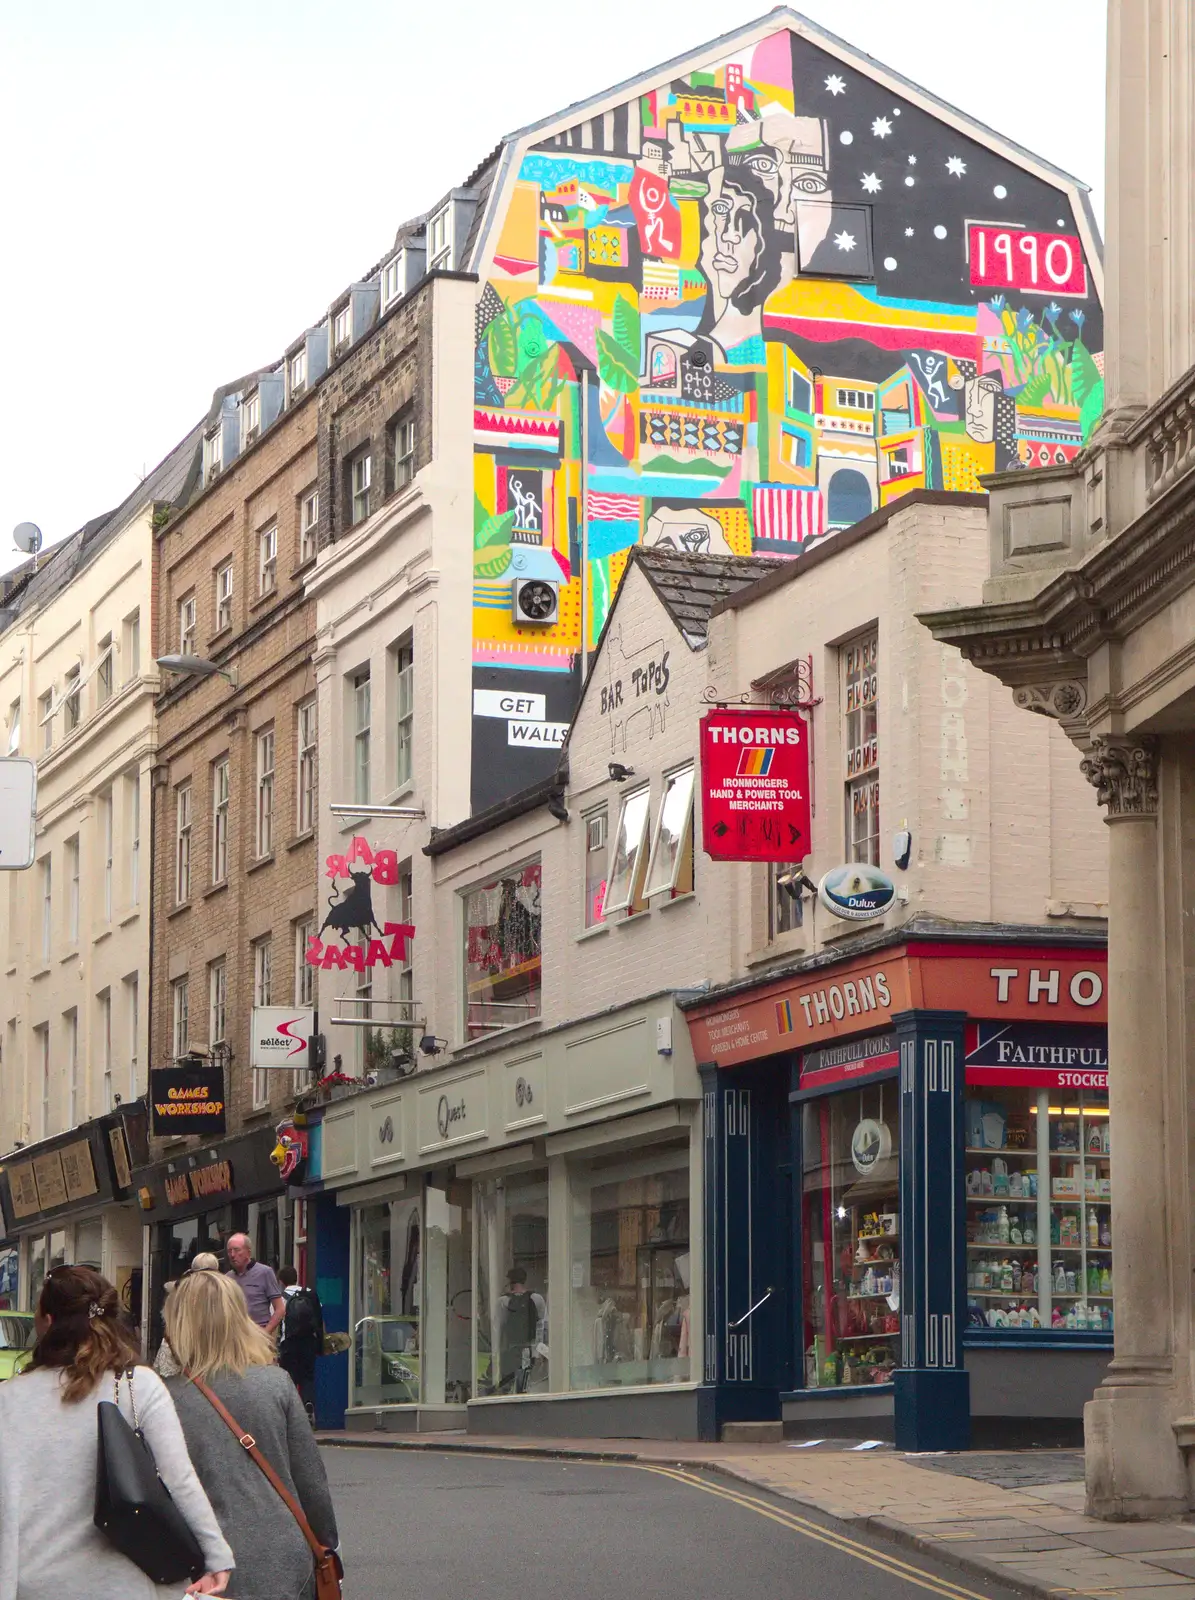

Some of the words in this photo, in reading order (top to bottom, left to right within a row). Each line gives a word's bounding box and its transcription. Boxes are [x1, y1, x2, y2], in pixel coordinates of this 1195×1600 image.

[979, 232, 1073, 285] 1990
[500, 698, 535, 714] GET
[601, 679, 624, 716] BAR
[512, 725, 569, 743] WALLS
[708, 726, 800, 745] THORNS
[848, 742, 877, 777] HOME
[723, 778, 788, 789] IRONMONGERS
[710, 789, 734, 798] HAND
[736, 789, 743, 799] &
[745, 789, 776, 800] POWER
[778, 789, 802, 800] TOOL
[729, 800, 784, 811] MERCHANTS
[848, 897, 876, 908] Dulux
[990, 968, 1104, 1007] THO
[800, 972, 891, 1028] THORNS
[735, 1035, 750, 1049] HOME
[750, 1029, 769, 1044] CENTRE
[820, 1045, 863, 1068] FAITHFULL
[863, 1036, 891, 1057] TOOLS
[996, 1040, 1108, 1066] FAITHFUL
[1058, 1073, 1109, 1087] STOCKE
[167, 1086, 209, 1099] GAMES
[154, 1102, 223, 1116] WORKSHOP
[437, 1094, 466, 1139] Quest
